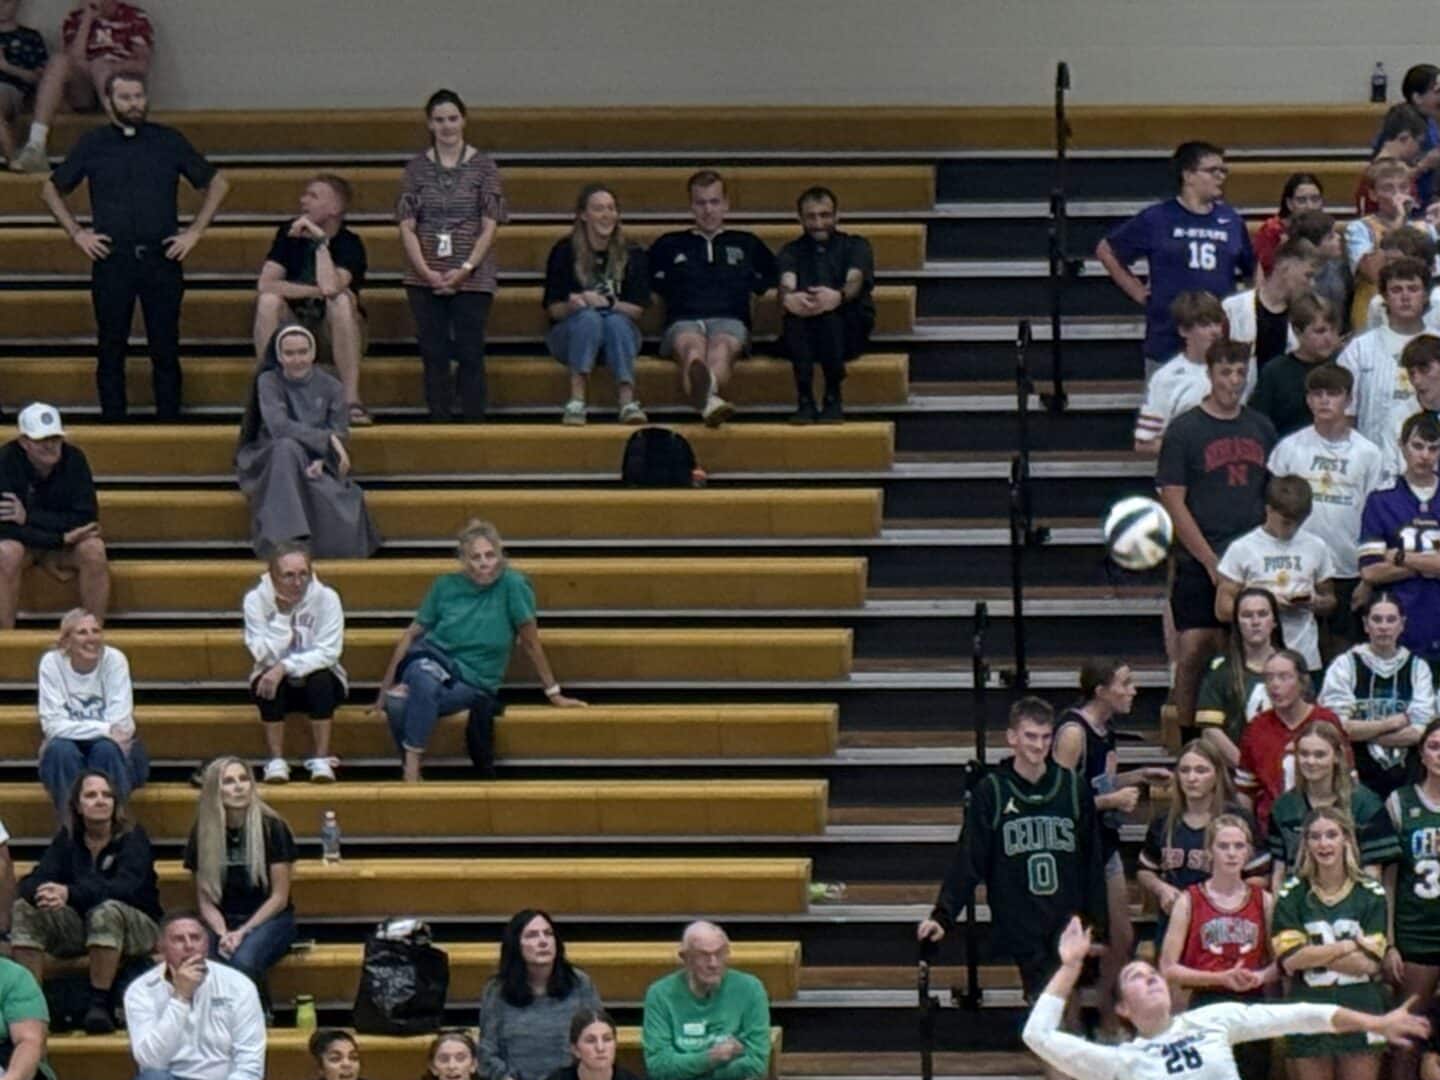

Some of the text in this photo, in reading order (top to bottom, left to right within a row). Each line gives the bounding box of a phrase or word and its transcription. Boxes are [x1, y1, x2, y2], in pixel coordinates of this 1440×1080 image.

[1189, 241, 1216, 270] 16
[1003, 816, 1075, 856] CELTICS
[1027, 852, 1058, 896] 0
